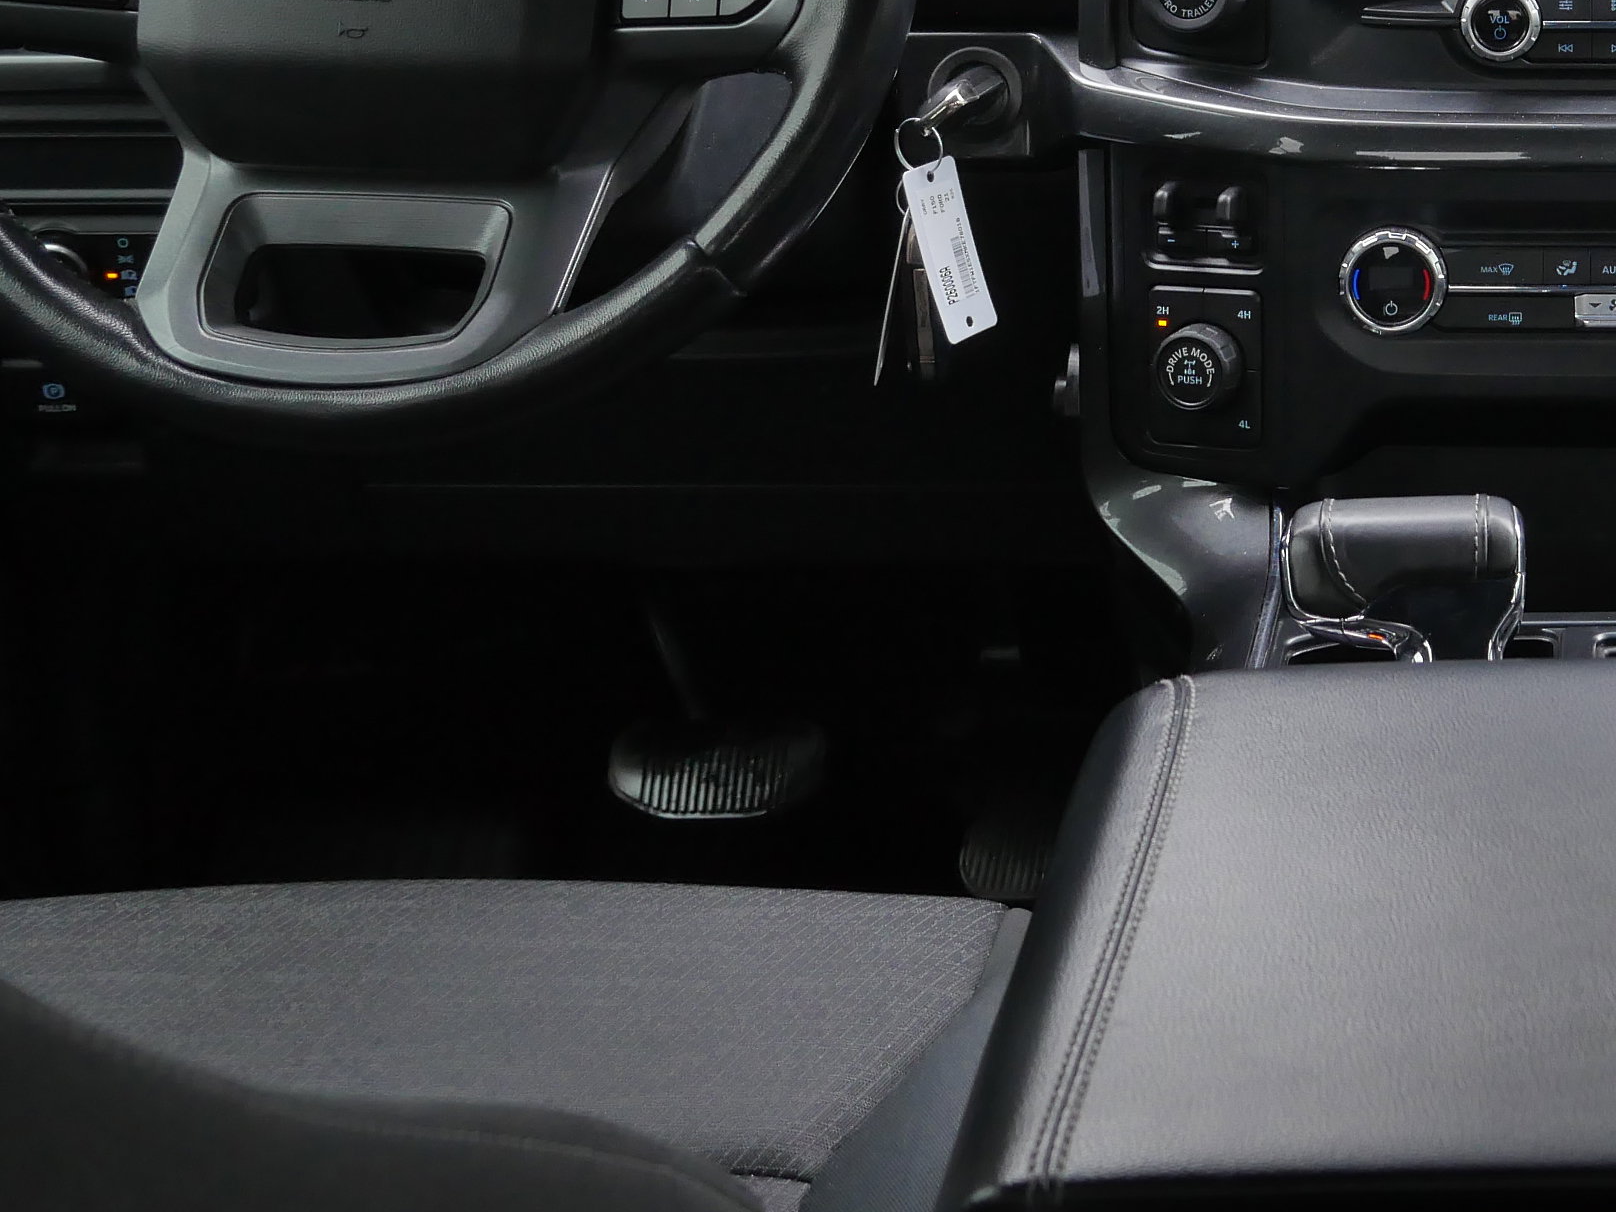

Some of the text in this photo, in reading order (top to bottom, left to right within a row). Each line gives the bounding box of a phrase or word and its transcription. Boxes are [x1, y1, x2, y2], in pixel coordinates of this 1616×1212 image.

[1489, 16, 1510, 25] VOL
[1156, 306, 1170, 315] 2H
[1237, 310, 1251, 319] 4H
[1166, 347, 1215, 375] DRIVE MODE
[1177, 375, 1203, 385] PUSH
[1238, 420, 1251, 429] 4L
